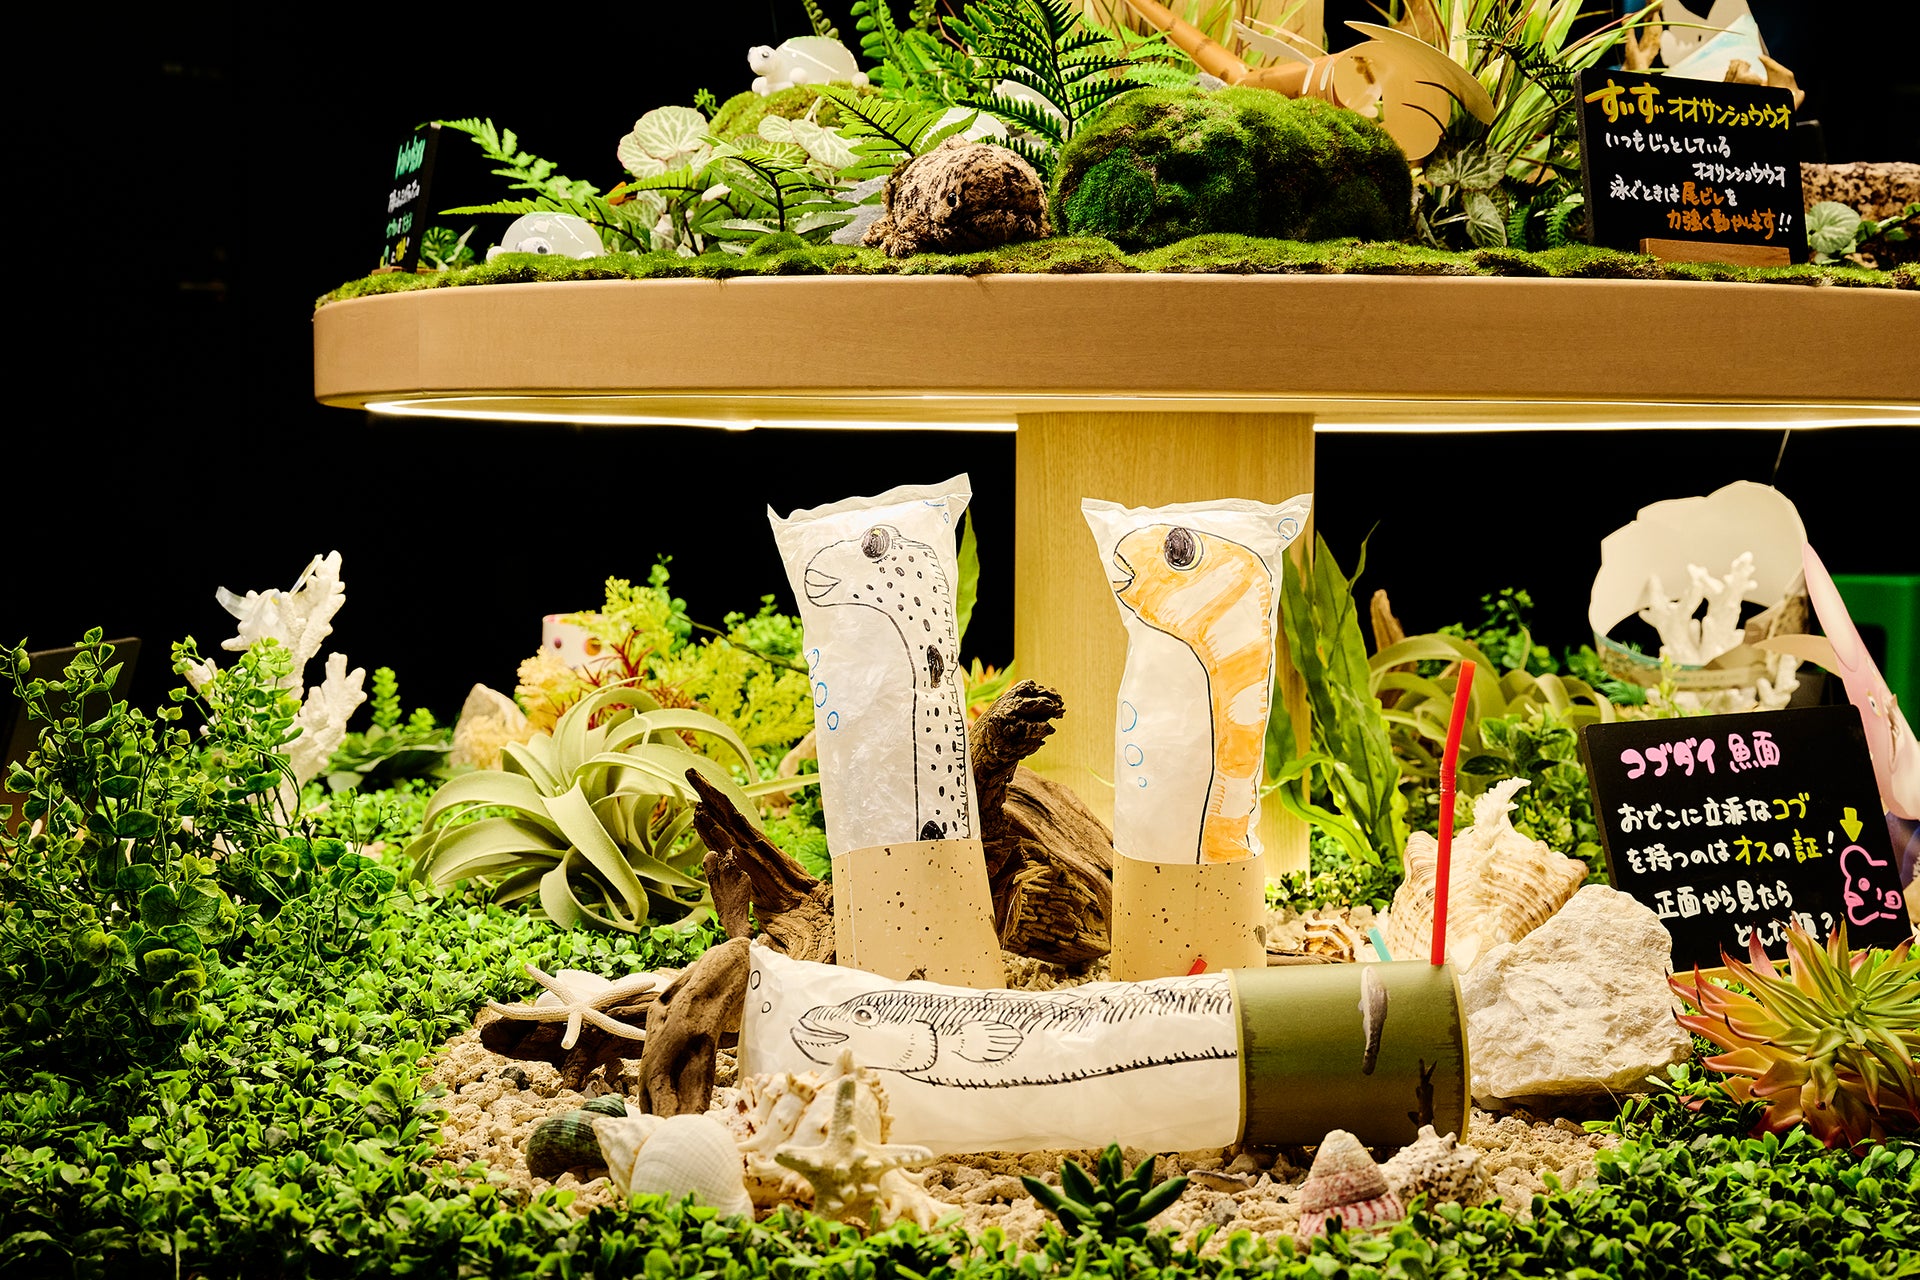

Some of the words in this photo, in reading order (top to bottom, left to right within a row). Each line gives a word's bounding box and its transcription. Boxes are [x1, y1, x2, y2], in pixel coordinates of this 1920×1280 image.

[1667, 96, 1792, 130] オオサンショウウオ
[1692, 161, 1786, 187] オオサンショウウオ
[1620, 736, 1716, 779] コブダイ
[1728, 731, 1781, 773] 魚面
[1617, 792, 1811, 833] おでこに立派なコブ
[1654, 880, 1793, 920] 正面から見たら
